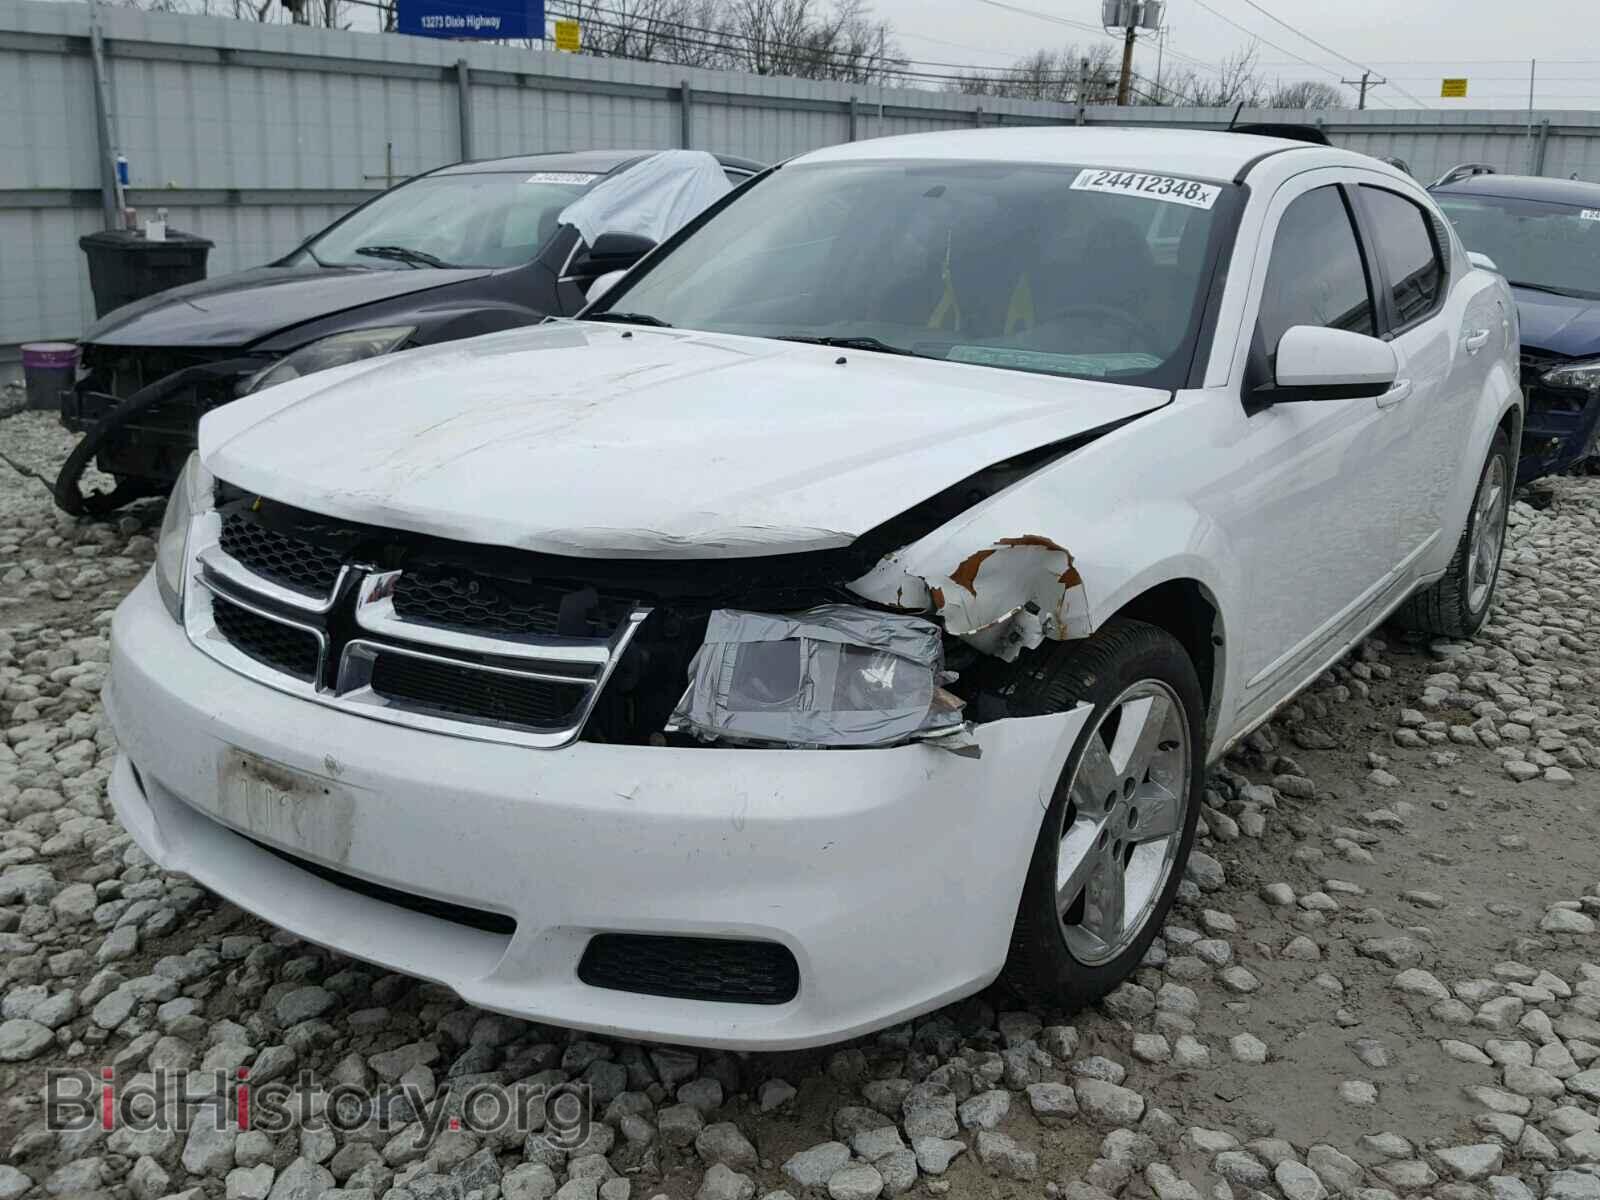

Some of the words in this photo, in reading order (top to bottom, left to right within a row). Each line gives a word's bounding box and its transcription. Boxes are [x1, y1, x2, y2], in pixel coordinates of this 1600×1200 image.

[421, 16, 443, 28] 13273
[445, 16, 465, 28] Dixie
[467, 15, 501, 30] Highway
